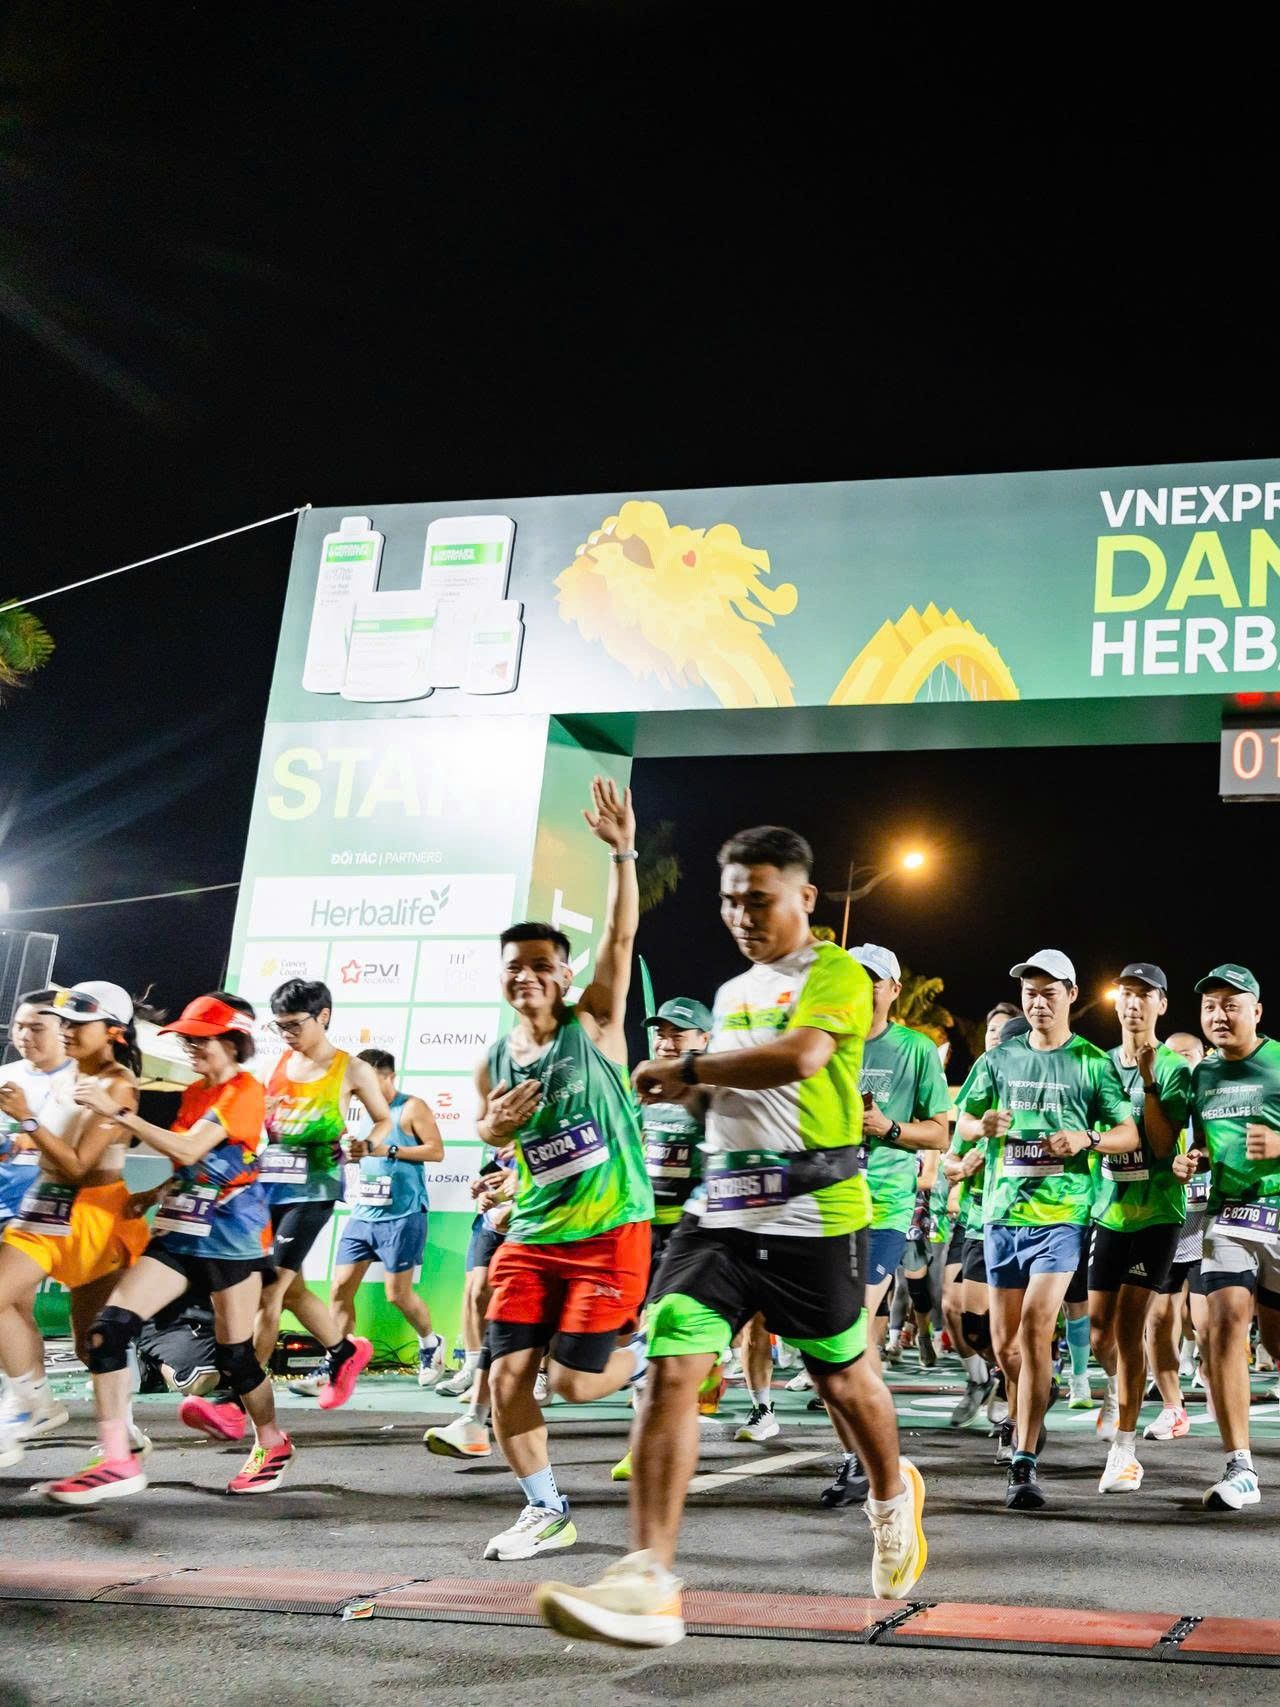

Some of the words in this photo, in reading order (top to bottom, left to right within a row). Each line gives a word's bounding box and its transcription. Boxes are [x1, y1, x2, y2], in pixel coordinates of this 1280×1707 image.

[310, 898, 437, 927] Herbalife
[363, 964, 400, 977] PVI
[419, 1033, 488, 1046] GARMIN
[580, 1126, 597, 1144] M
[1133, 1151, 1144, 1164] M
[1265, 1212, 1277, 1227] M
